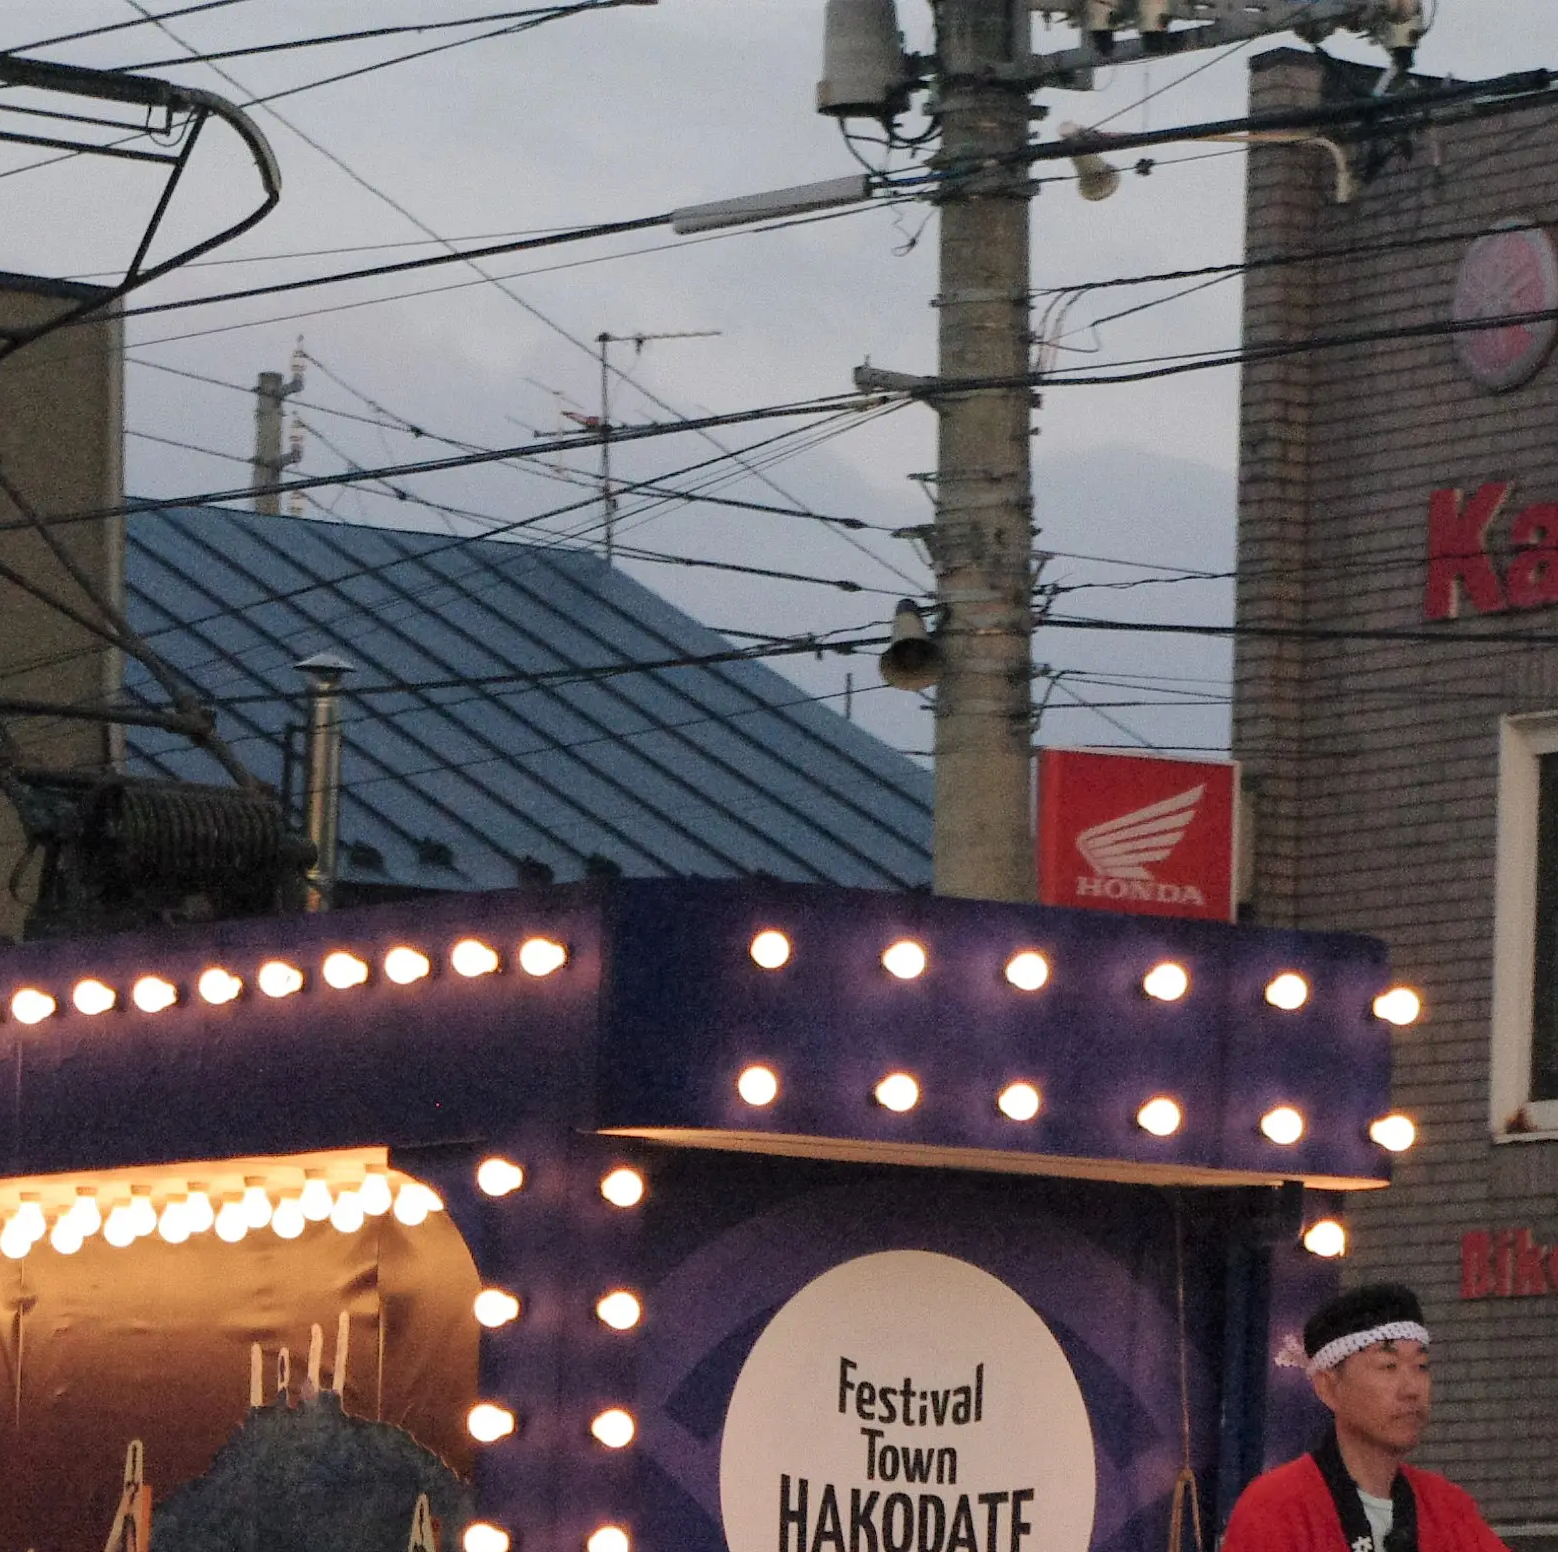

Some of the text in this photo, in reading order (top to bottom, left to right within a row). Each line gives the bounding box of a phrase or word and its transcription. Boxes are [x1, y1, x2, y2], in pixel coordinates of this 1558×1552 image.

[1075, 875, 1206, 906] HONDA
[837, 1355, 985, 1427] Festival
[859, 1426, 958, 1485] Town
